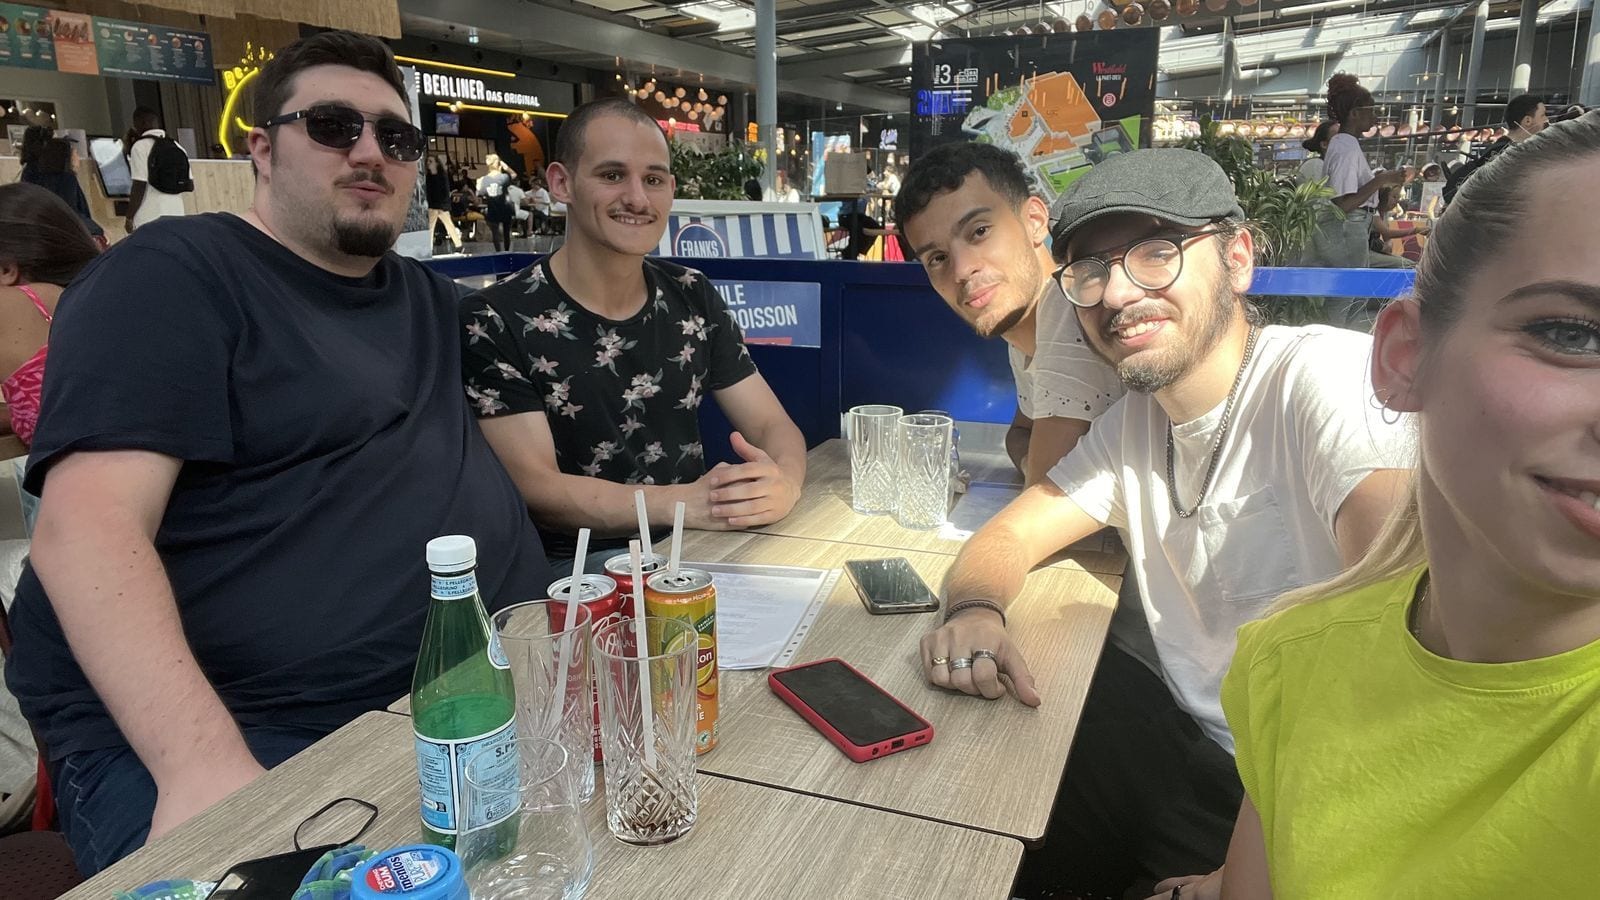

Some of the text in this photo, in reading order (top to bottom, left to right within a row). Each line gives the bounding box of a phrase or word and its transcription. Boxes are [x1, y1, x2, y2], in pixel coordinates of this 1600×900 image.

[940, 64, 951, 84] 3
[423, 72, 541, 107] BERLINER DAS ORIGINAL
[680, 240, 719, 257] FRANKS
[378, 865, 395, 889] GUM
[390, 856, 414, 890] mentos
